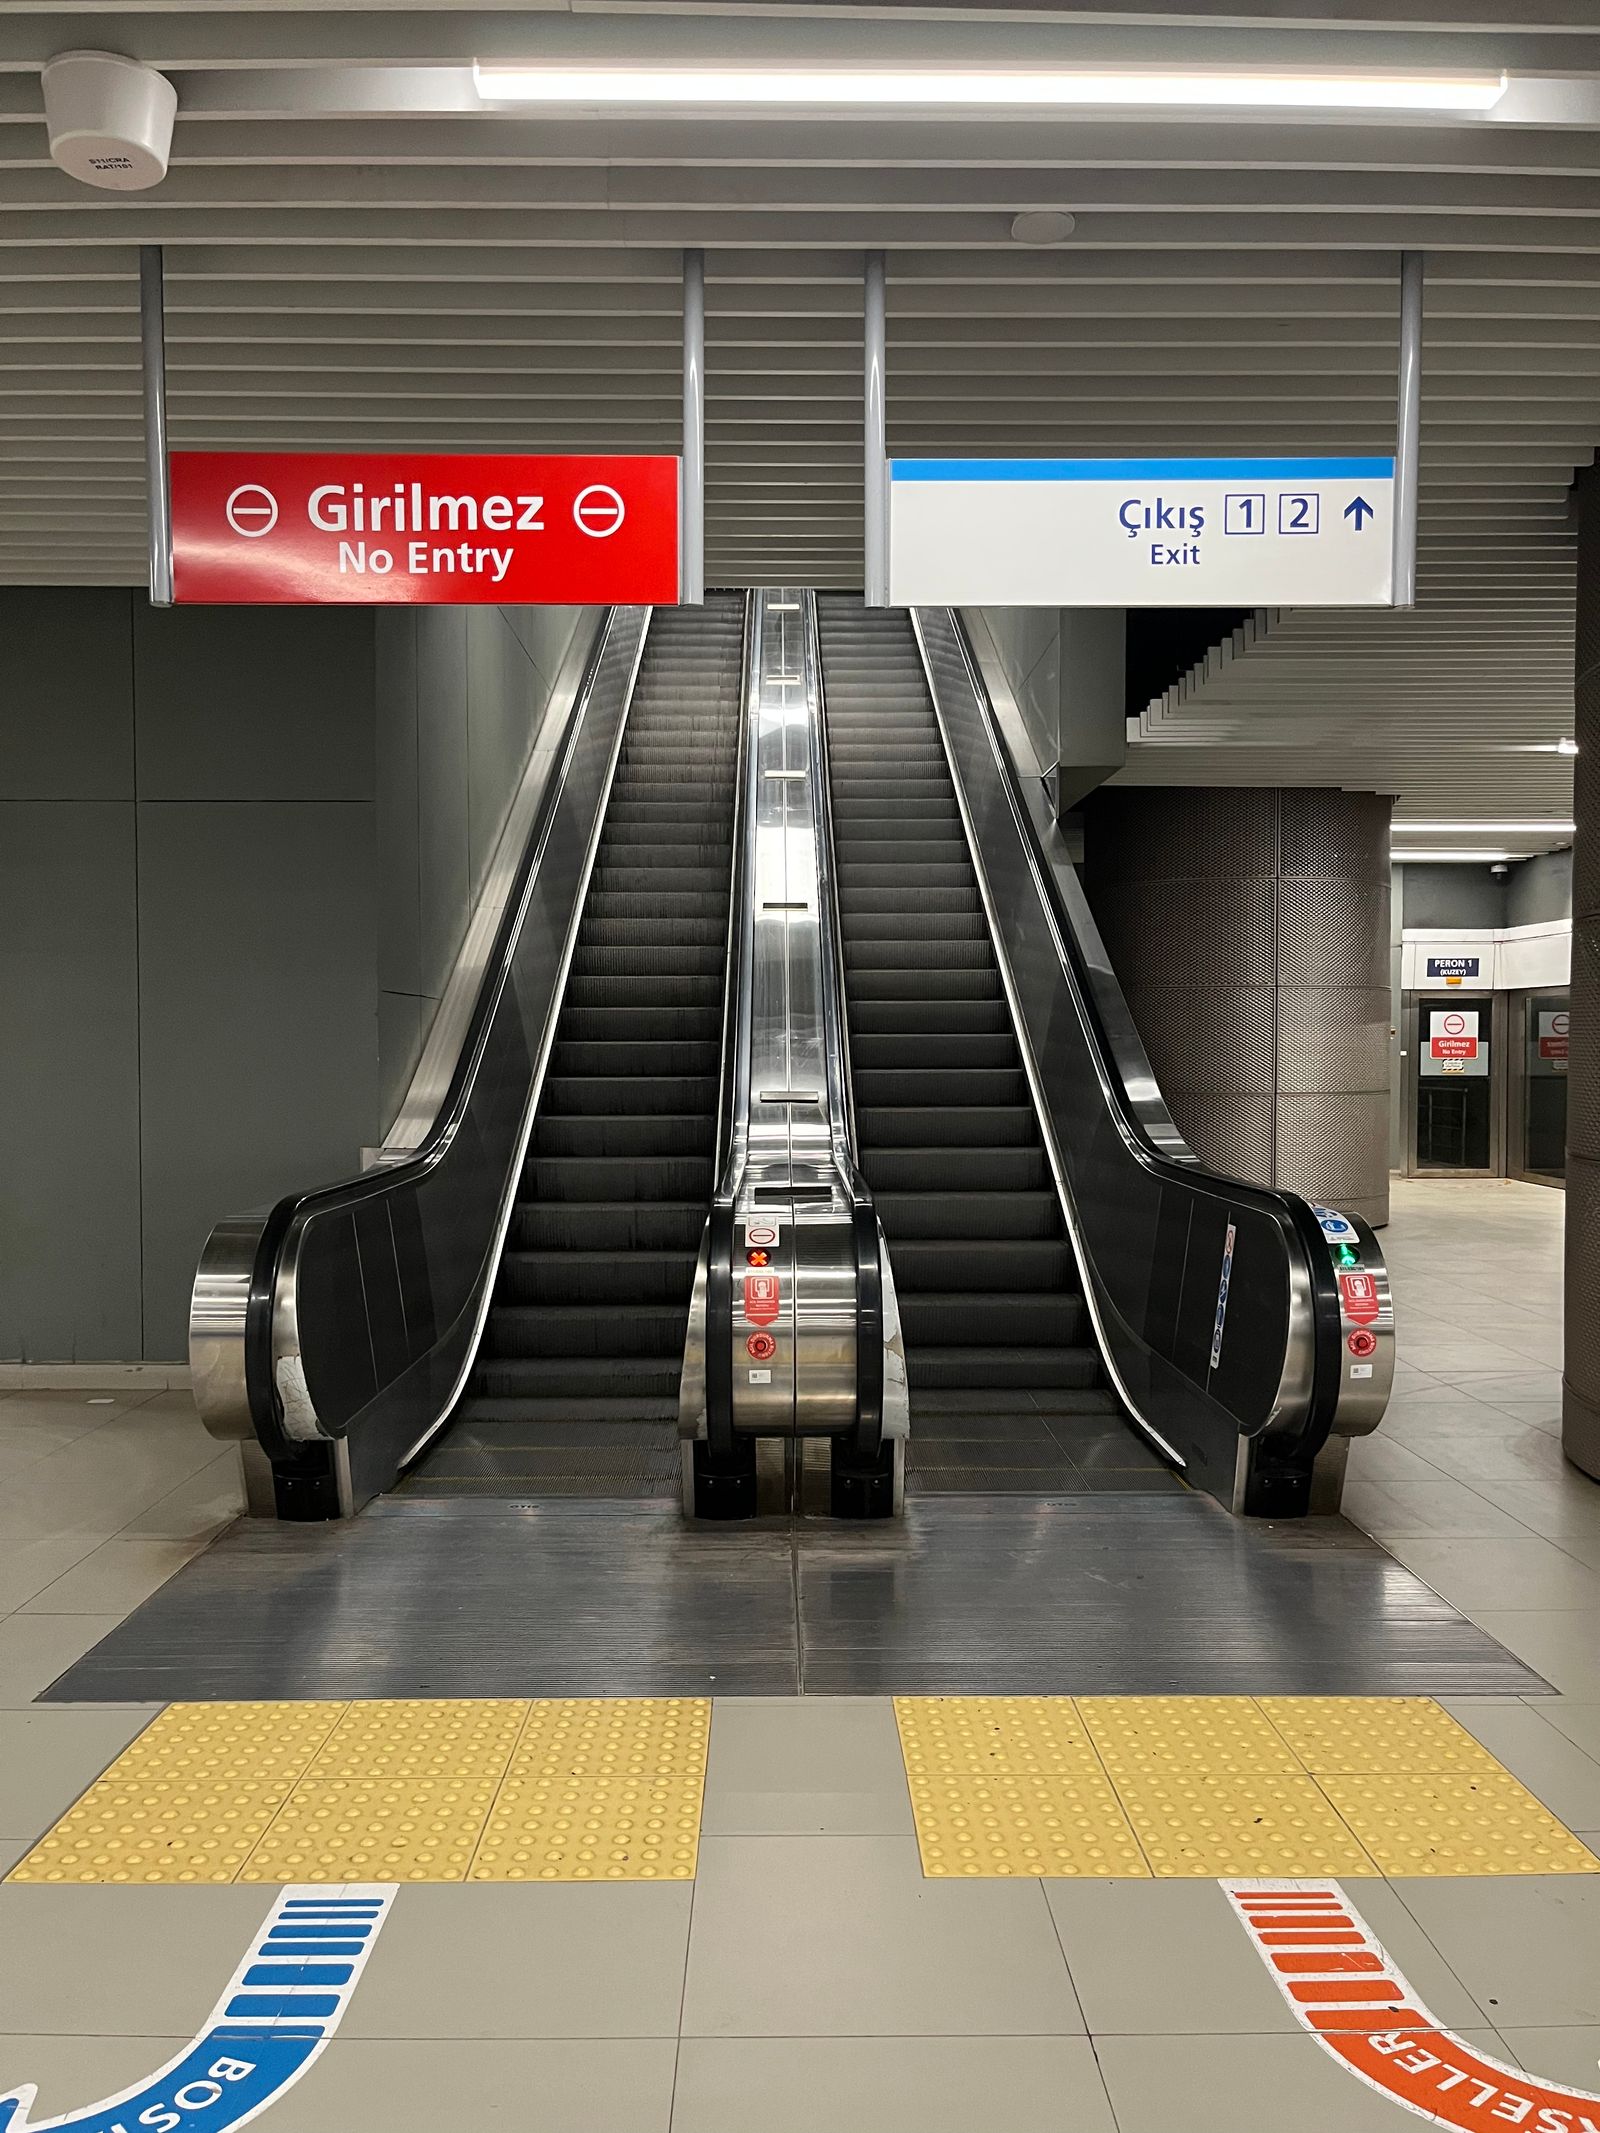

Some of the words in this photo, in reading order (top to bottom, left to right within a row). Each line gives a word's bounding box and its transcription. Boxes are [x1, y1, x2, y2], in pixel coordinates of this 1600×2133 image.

[308, 483, 544, 532] Girilmez
[1119, 497, 1205, 538] Çıkış
[1238, 498, 1253, 529] 1
[1289, 498, 1310, 528] 2
[337, 542, 393, 574] No
[409, 541, 514, 581] Entry
[1151, 543, 1200, 565] Exit
[1434, 959, 1465, 968] PERON
[1467, 959, 1472, 968] 1
[1438, 1040, 1470, 1048] Girilmez
[111, 2056, 256, 2133] BOS
[1368, 2033, 1600, 2133] SELLER
